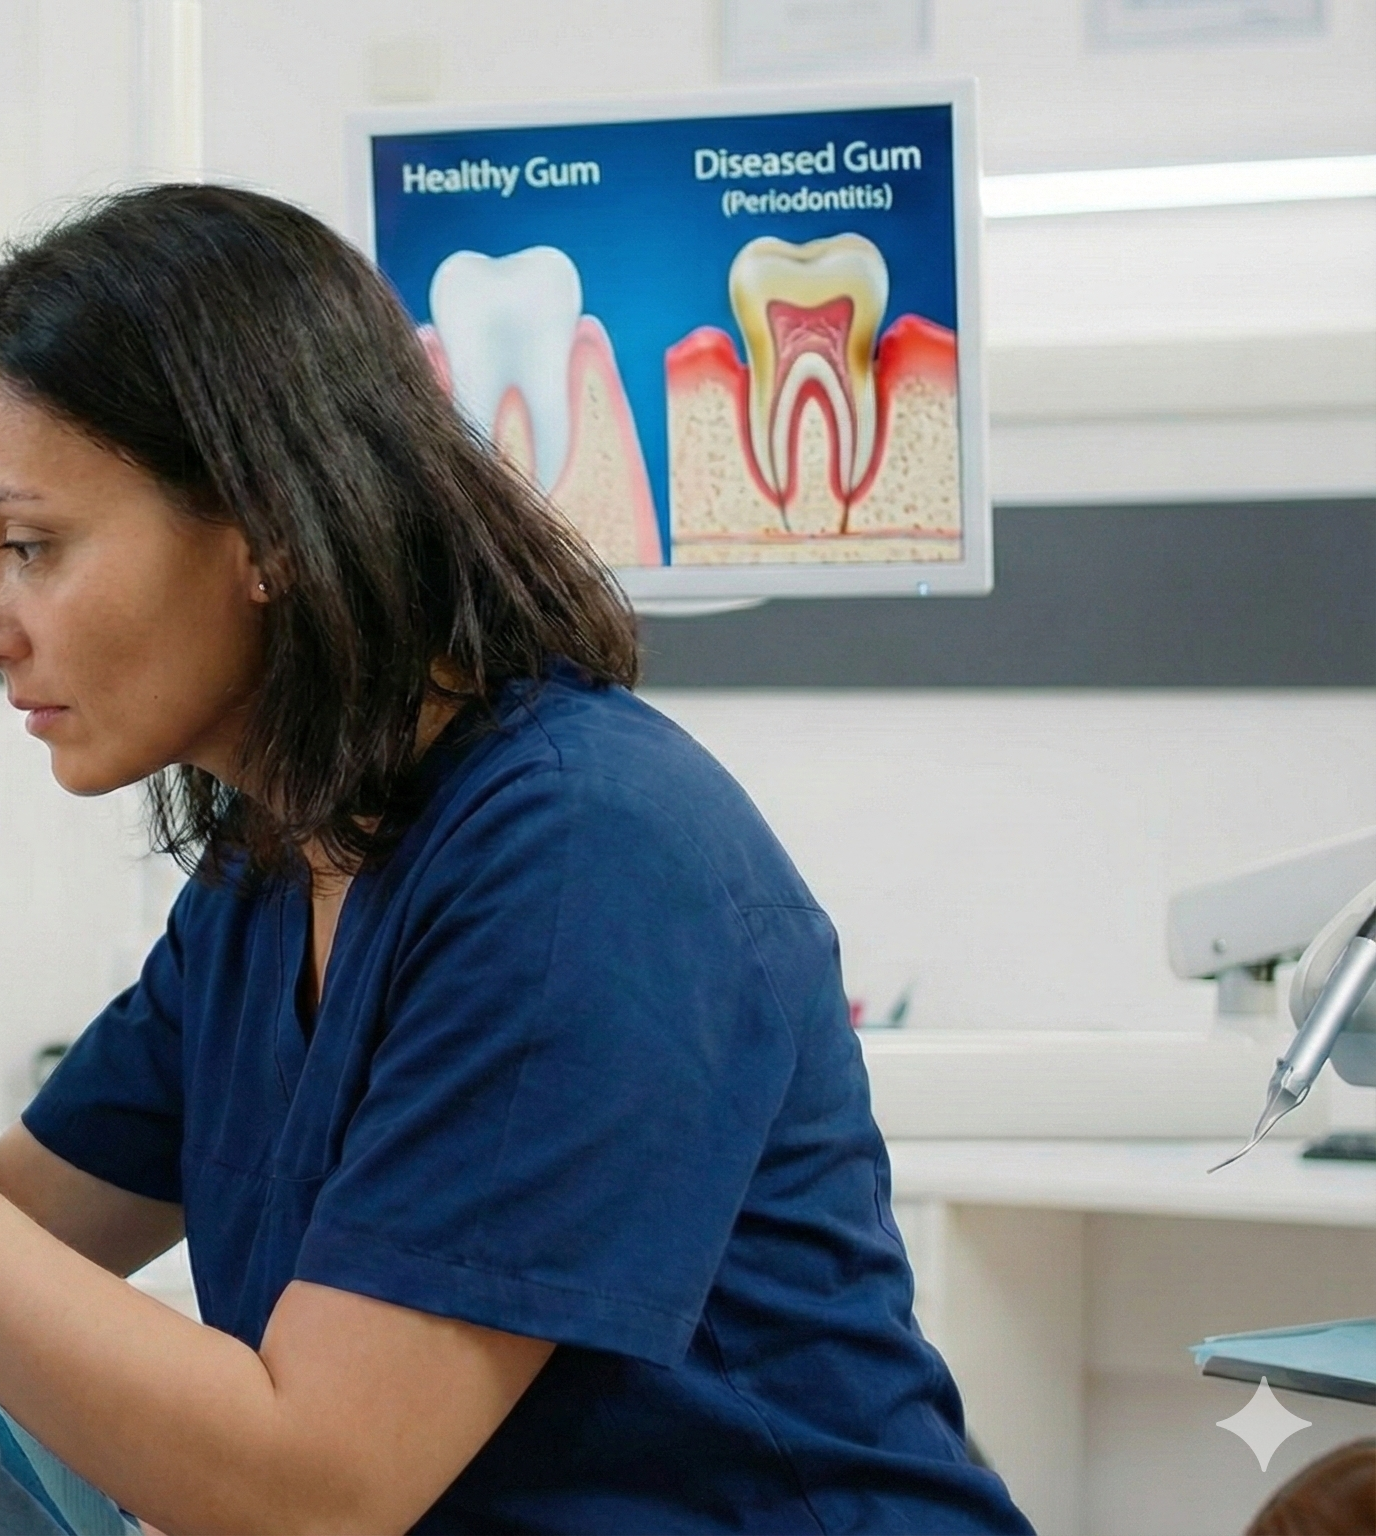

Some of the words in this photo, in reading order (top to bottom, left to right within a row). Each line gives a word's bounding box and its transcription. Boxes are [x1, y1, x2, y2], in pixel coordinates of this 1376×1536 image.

[402, 160, 519, 196] Healthy
[525, 157, 600, 187] Gum
[694, 142, 834, 180] Diseased
[843, 140, 922, 172] Gum
[722, 184, 893, 217] (Periodontitis)
